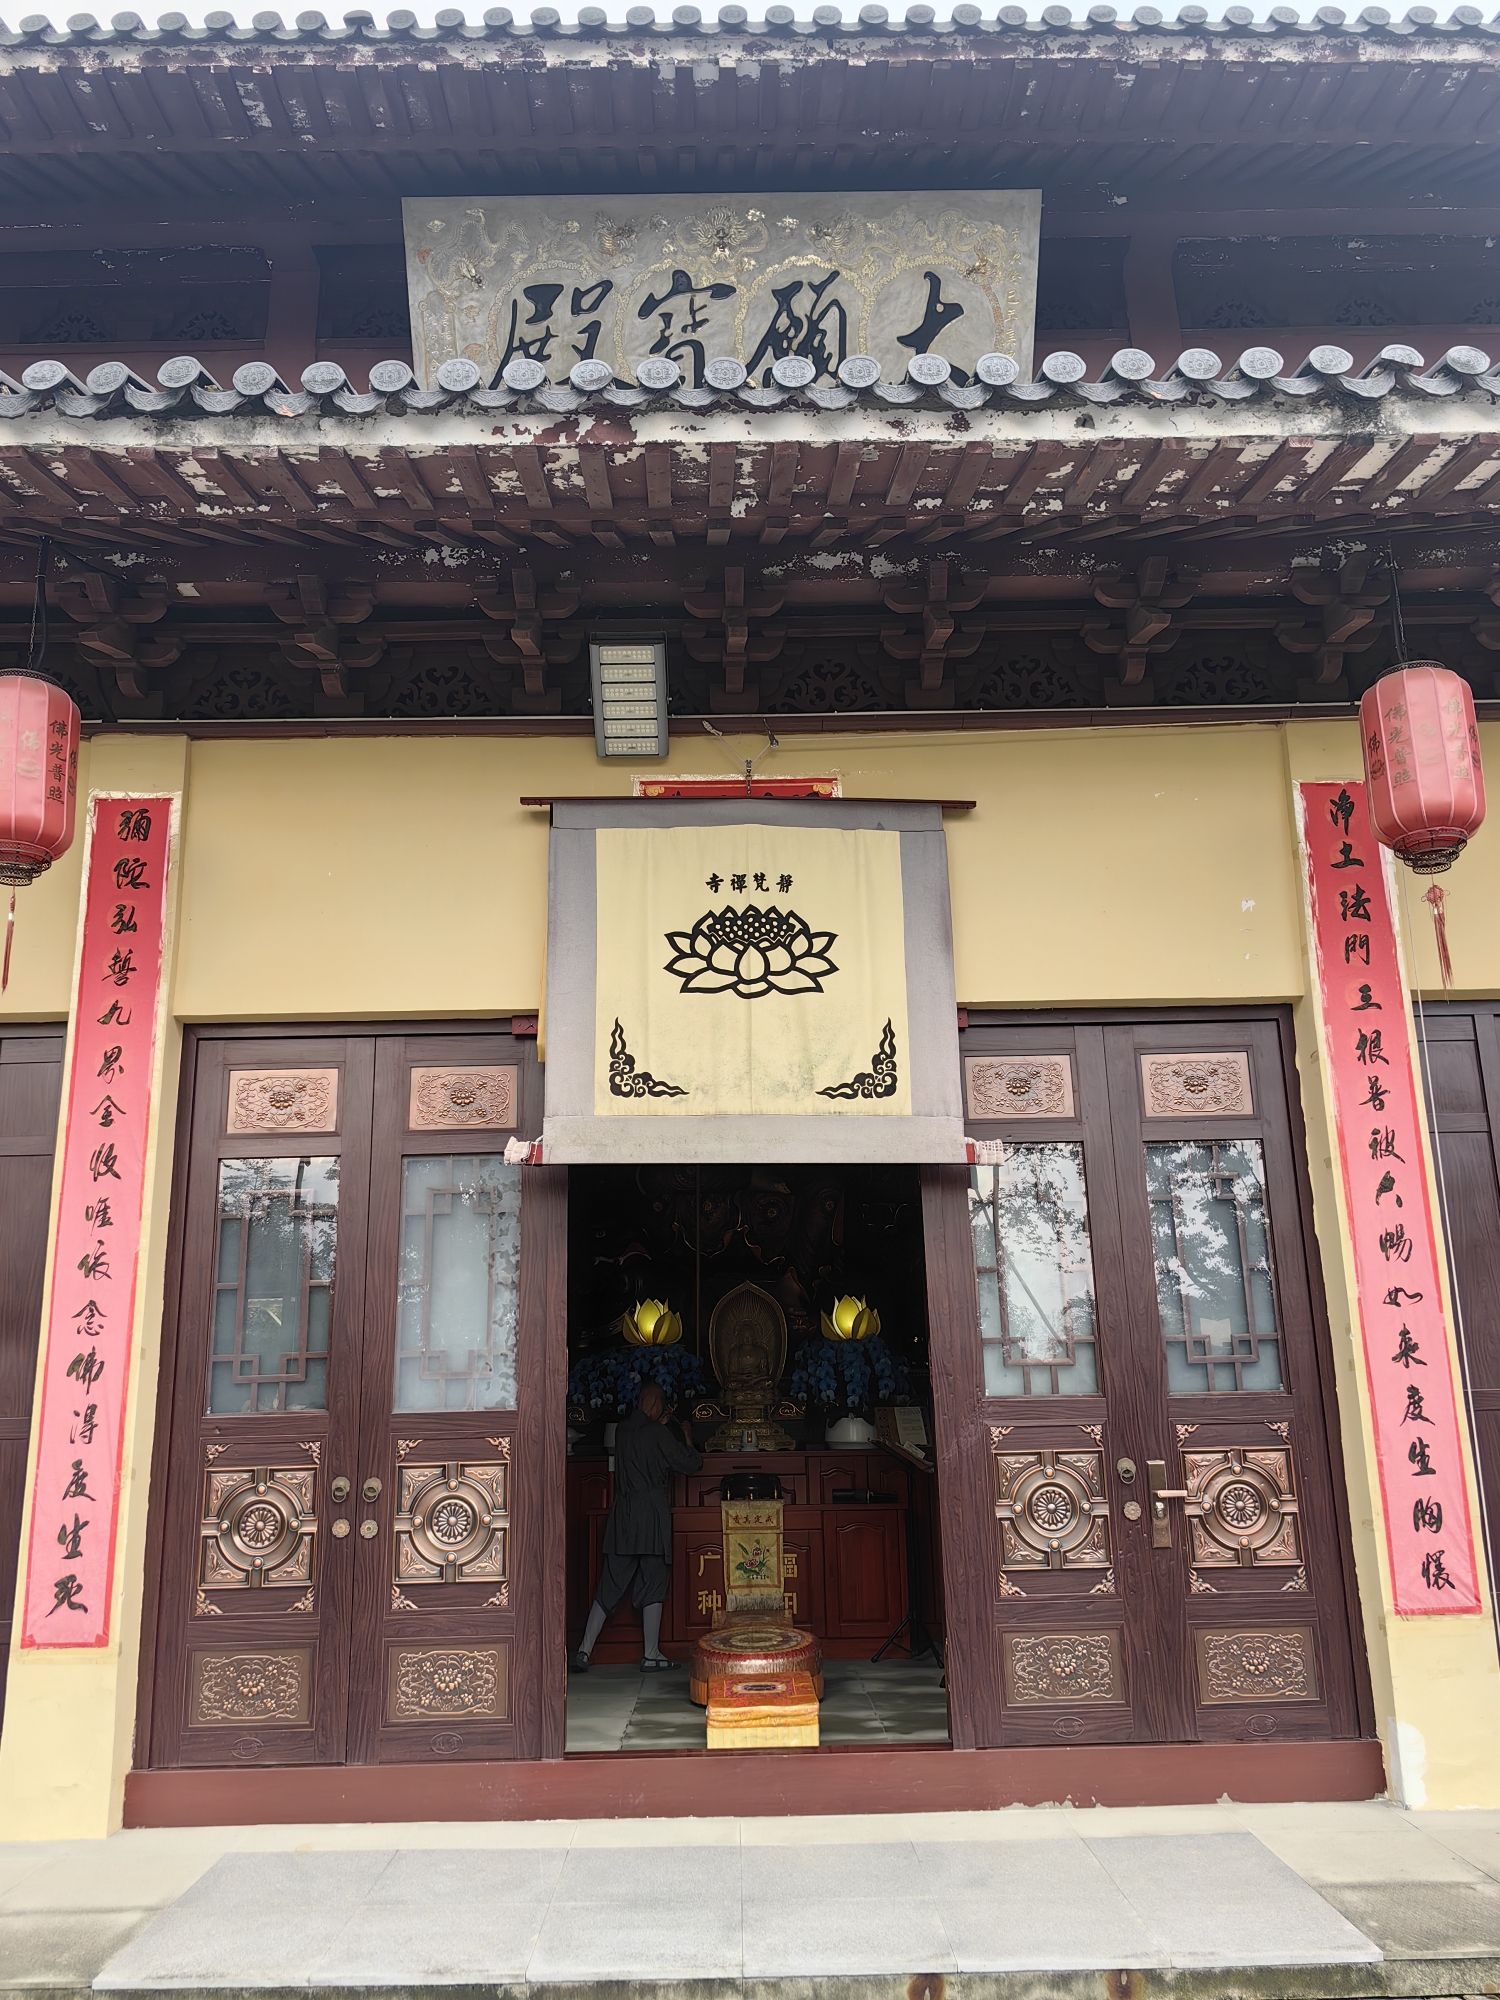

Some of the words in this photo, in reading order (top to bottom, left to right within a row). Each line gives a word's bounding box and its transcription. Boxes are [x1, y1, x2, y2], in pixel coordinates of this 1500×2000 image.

[47, 720, 69, 804] 佛光普照
[1384, 702, 1416, 789] 佛光普照
[705, 872, 794, 894] 靜梵禪寺
